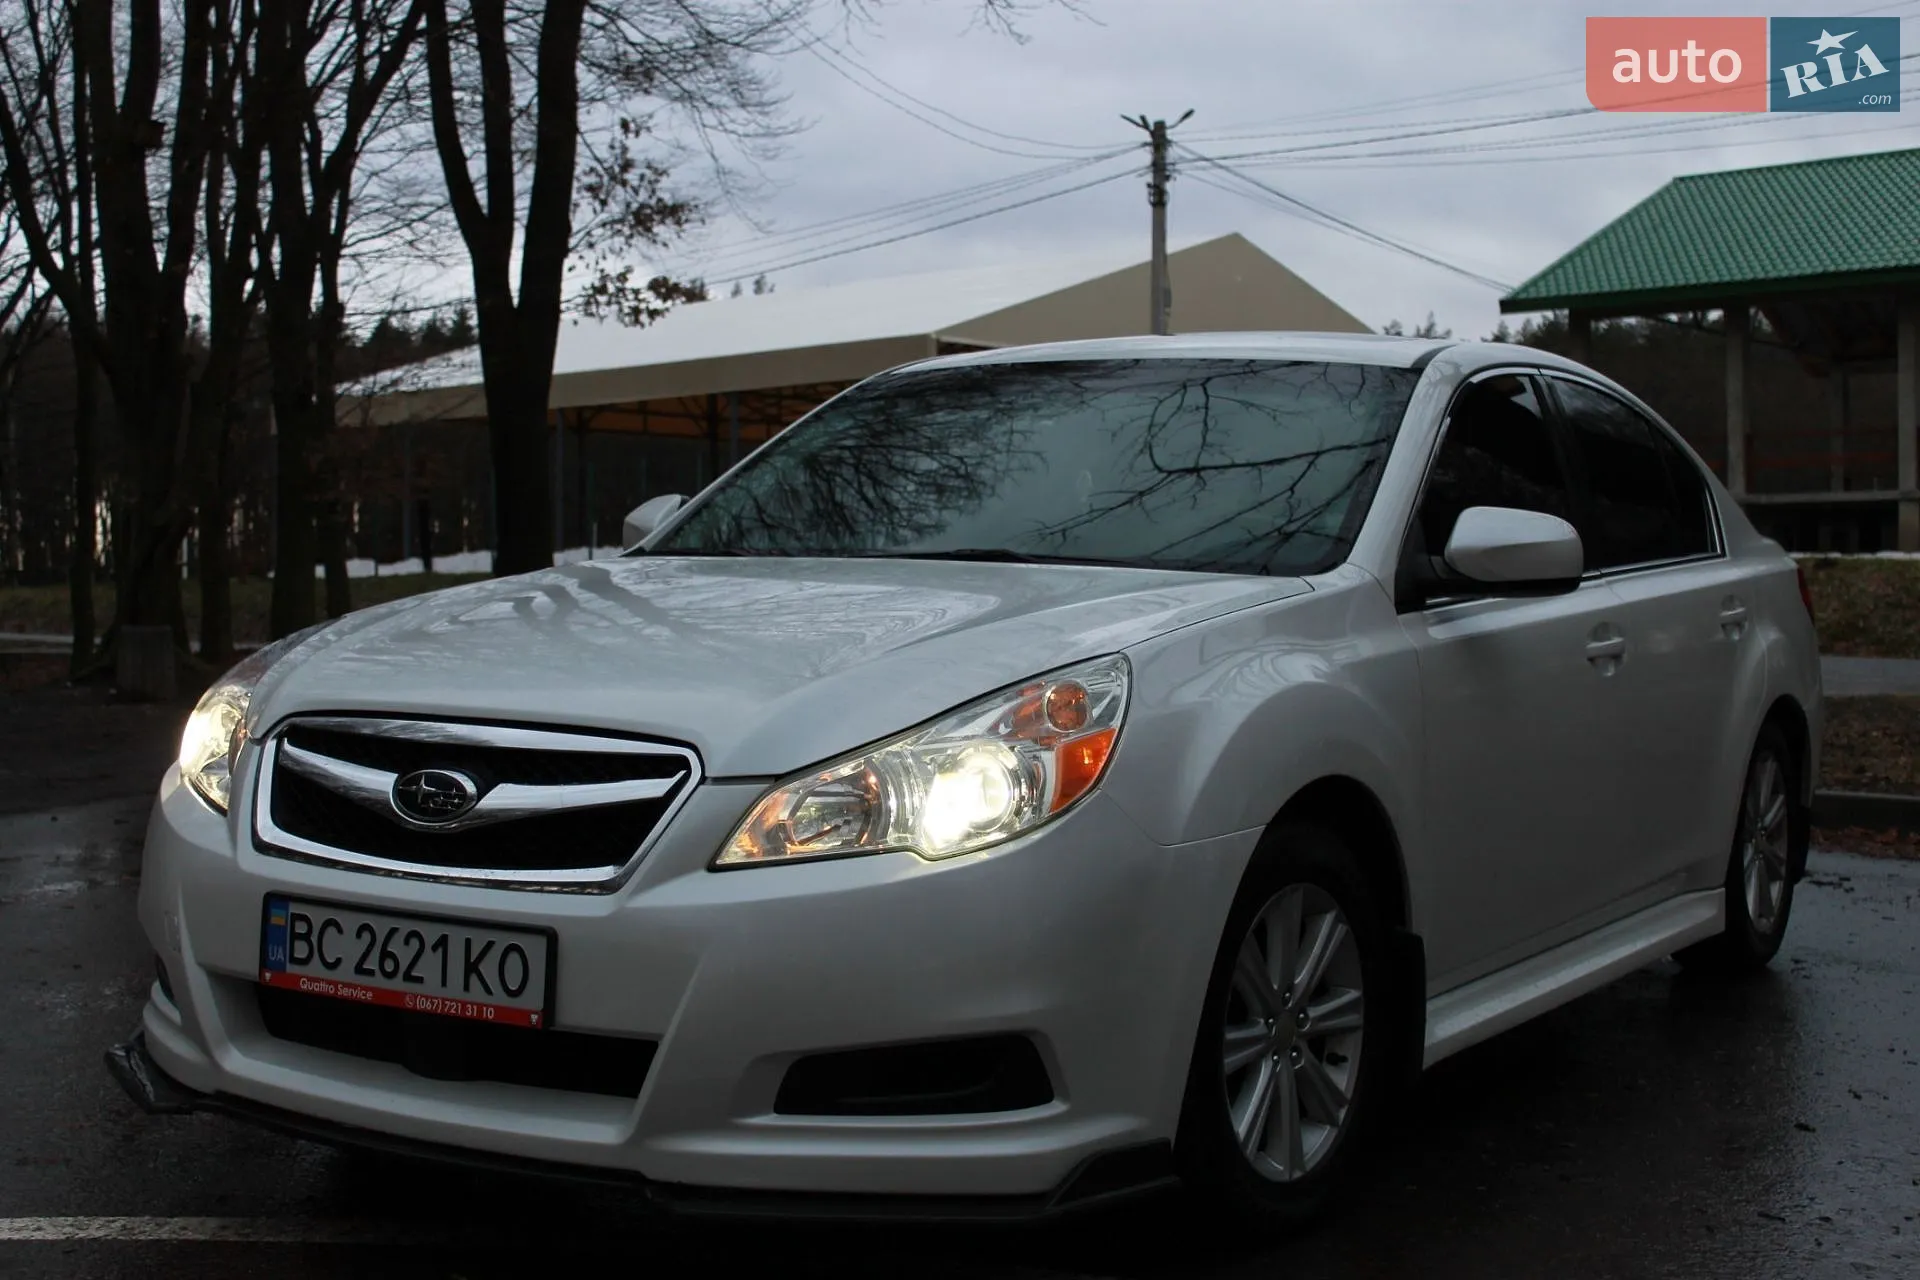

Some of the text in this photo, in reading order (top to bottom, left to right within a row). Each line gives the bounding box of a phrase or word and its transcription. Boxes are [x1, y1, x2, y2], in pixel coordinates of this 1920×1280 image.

[269, 944, 284, 962] UA
[289, 912, 344, 970] BC
[354, 922, 449, 988] 2621
[300, 978, 373, 1001] Quattro Service
[416, 996, 495, 1020] (067) 721 31 10
